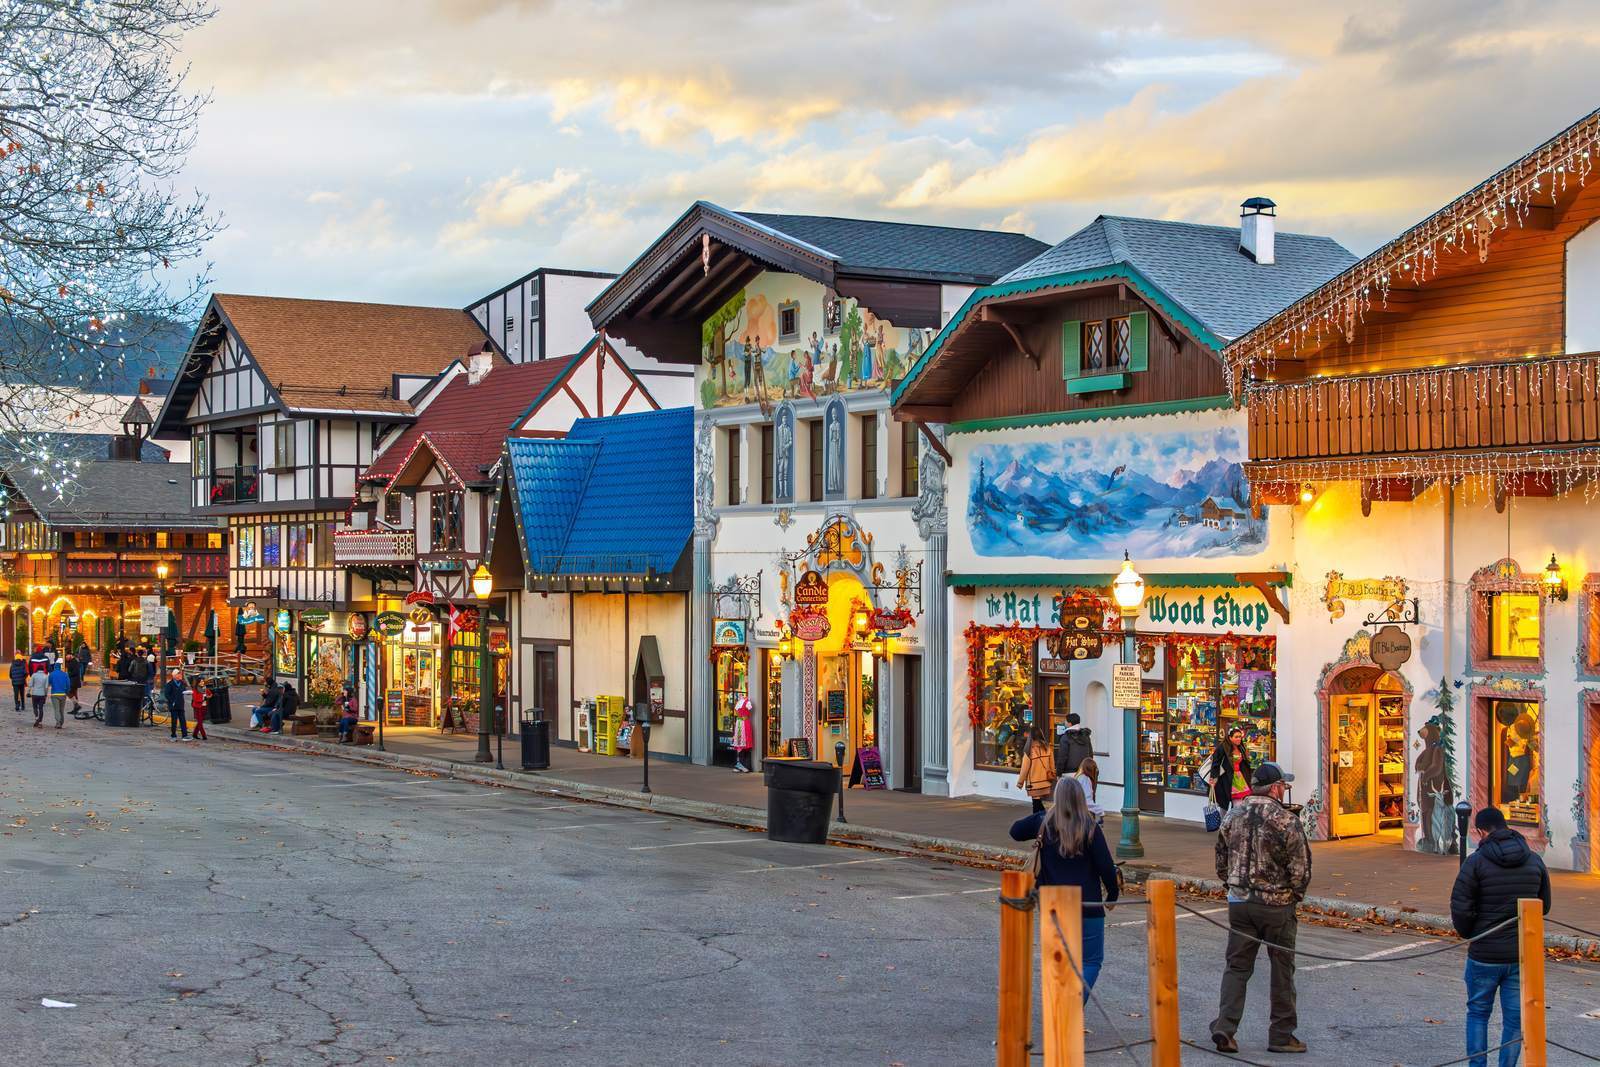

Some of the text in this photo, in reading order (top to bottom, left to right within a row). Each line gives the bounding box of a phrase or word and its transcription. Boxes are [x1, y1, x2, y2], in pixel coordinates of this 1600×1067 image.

[797, 585, 827, 596] Candle
[1003, 590, 1041, 623] Hat
[1144, 592, 1205, 625] Wood
[1212, 592, 1269, 632] Shop
[1066, 636, 1098, 648] Hat Shop
